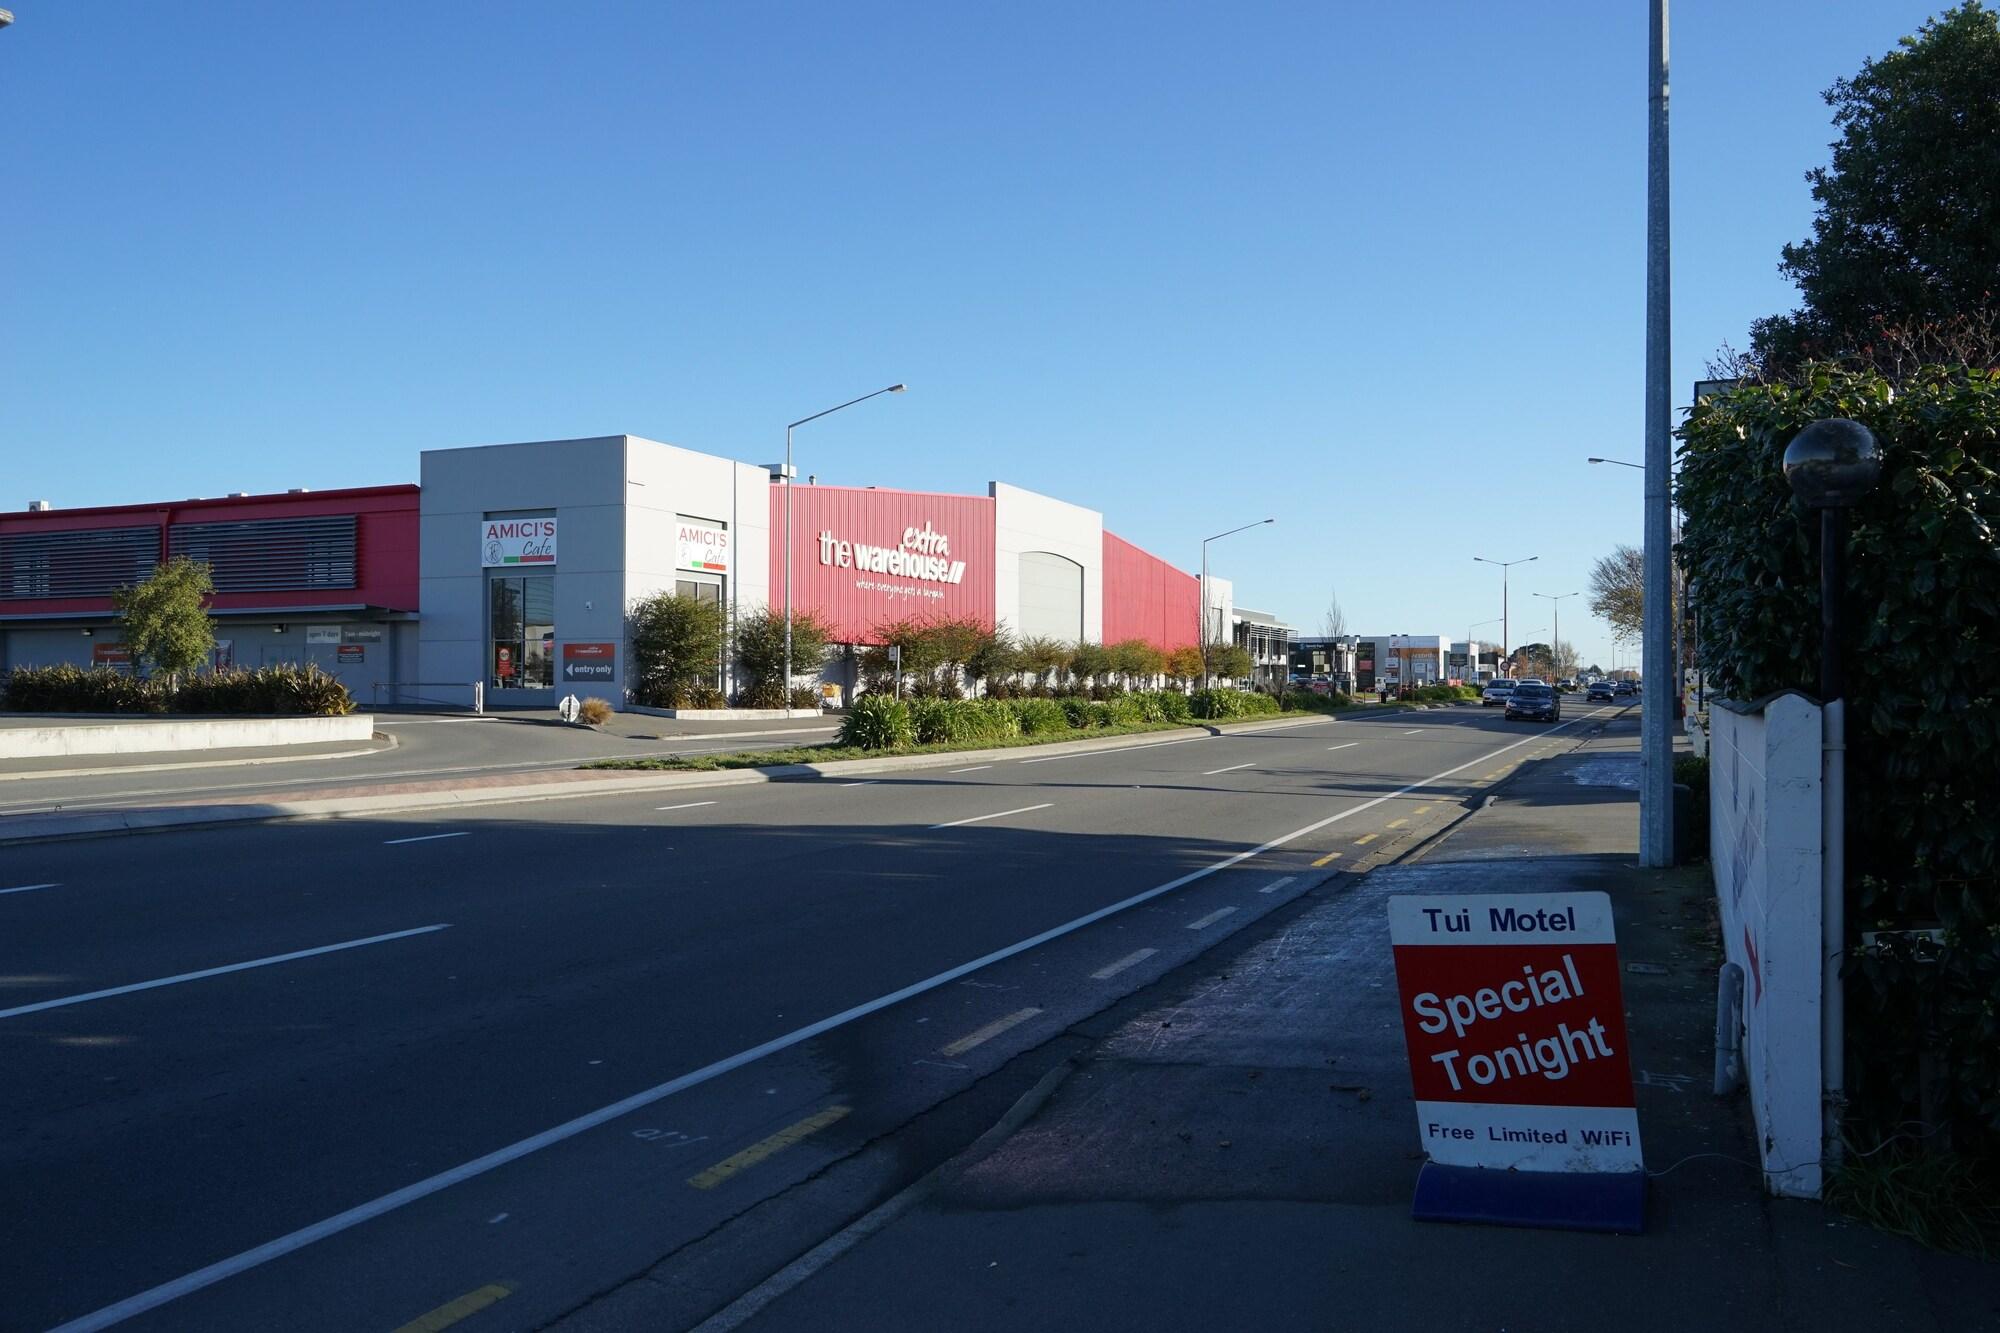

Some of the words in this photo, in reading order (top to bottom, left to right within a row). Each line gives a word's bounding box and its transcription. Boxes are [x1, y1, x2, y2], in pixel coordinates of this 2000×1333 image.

[487, 521, 555, 539] AMICI'S
[680, 527, 727, 548] AMICI'S
[902, 521, 950, 556] extra
[523, 538, 552, 558] Cafe
[705, 548, 726, 566] Cafe
[818, 530, 851, 568] the
[853, 543, 949, 582] warehouse
[574, 665, 595, 675] entry
[595, 664, 612, 675] only
[1422, 908, 1471, 932] Tui
[1490, 906, 1576, 932] Motel
[1412, 953, 1585, 1038] Special
[1430, 1016, 1615, 1091] Tonight
[1428, 1123, 1475, 1141] Free
[1488, 1126, 1568, 1145] Limited
[1581, 1129, 1632, 1147] WiFi
